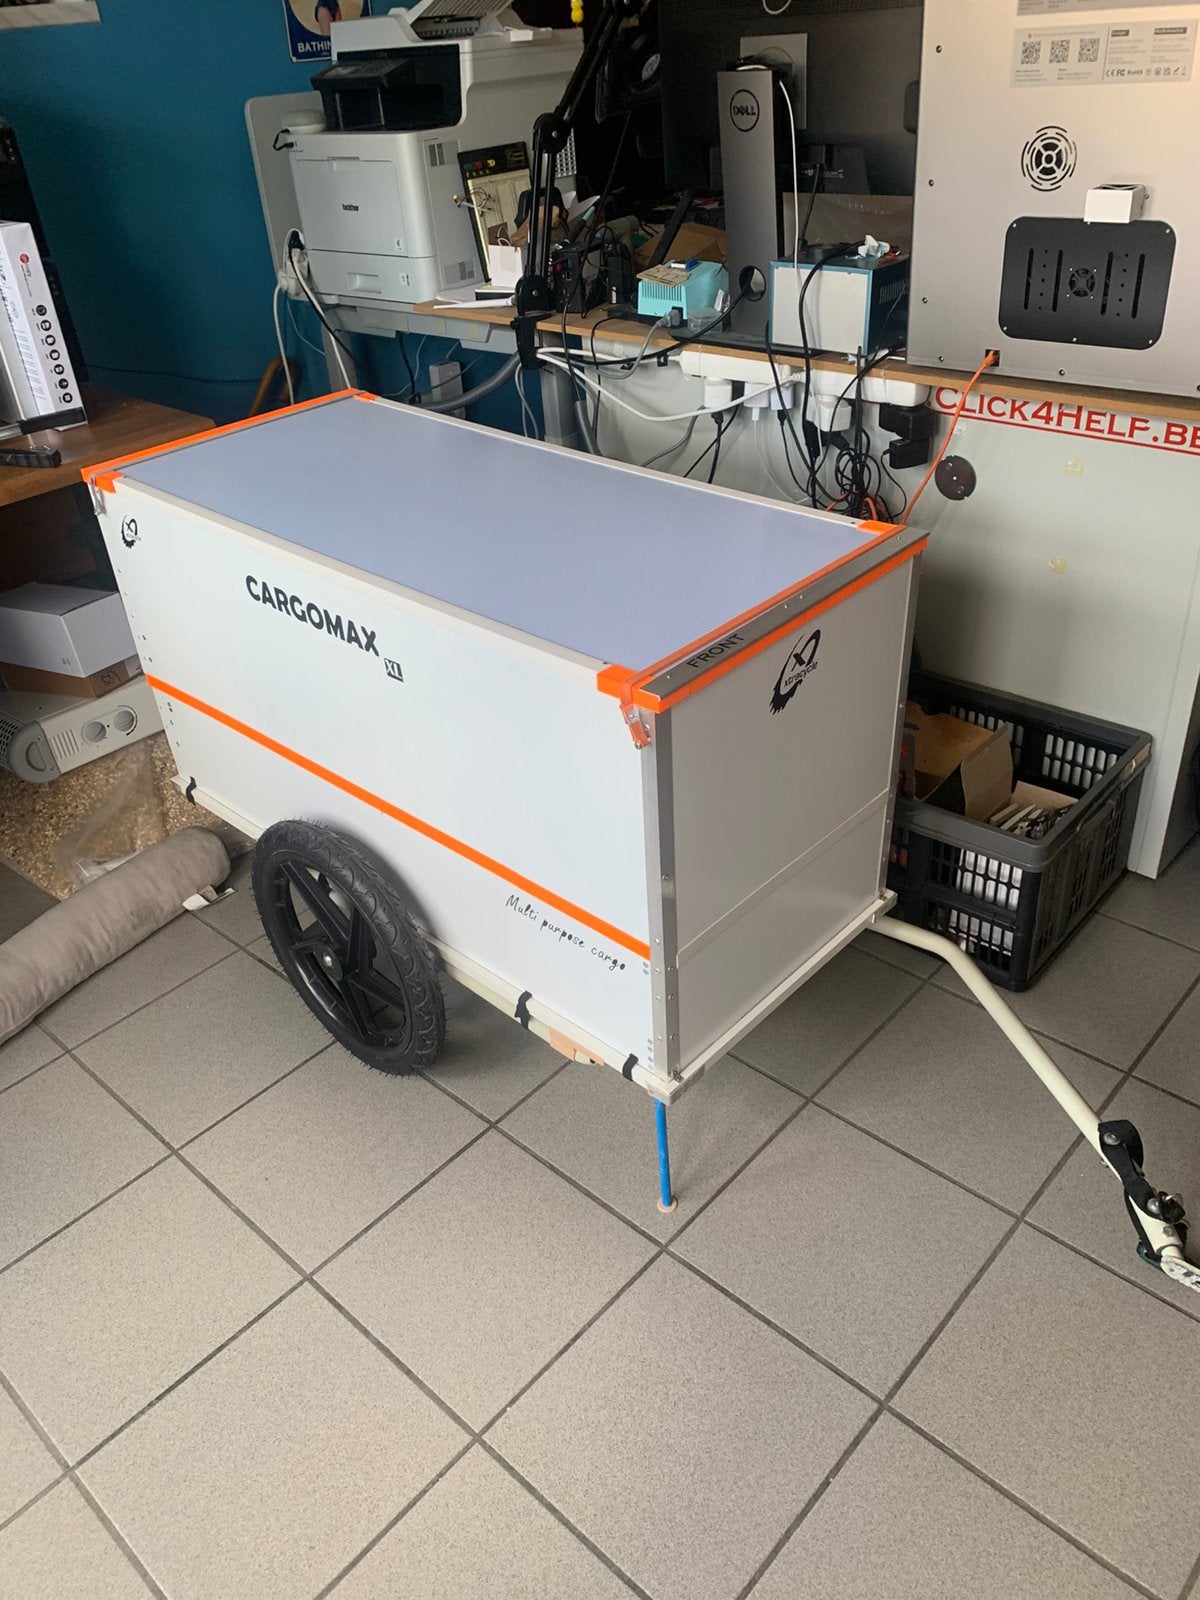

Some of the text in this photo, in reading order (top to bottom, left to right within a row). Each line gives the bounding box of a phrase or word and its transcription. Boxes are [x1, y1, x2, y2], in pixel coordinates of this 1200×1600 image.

[732, 105, 757, 116] DELL
[245, 575, 380, 657] CARGOMAX
[686, 633, 745, 668] FRONT
[384, 657, 404, 683] XL
[783, 661, 819, 688] xtracycle
[505, 895, 627, 972] Multi purpose cargo
